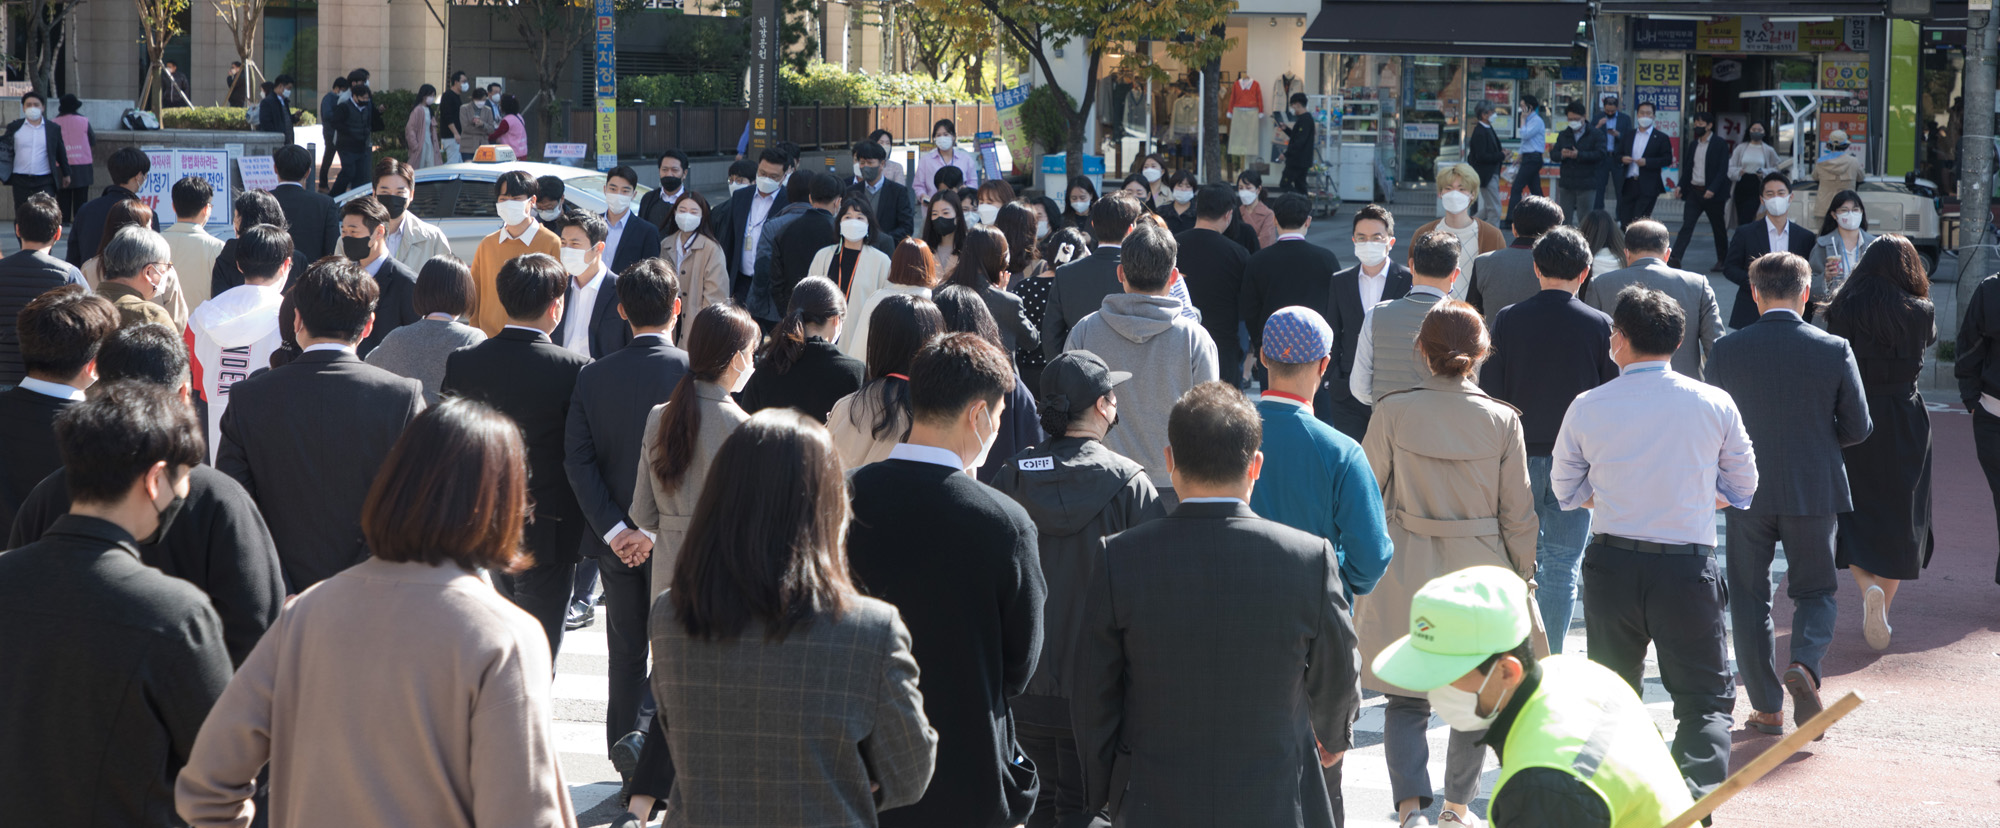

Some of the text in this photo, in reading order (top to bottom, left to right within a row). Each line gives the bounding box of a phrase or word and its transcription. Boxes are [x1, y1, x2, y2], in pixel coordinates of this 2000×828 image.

[599, 17, 610, 31] P
[758, 16, 767, 59] 한강공원
[1744, 29, 1796, 44] 황소갈비
[599, 34, 613, 82] 주차장
[1598, 74, 1610, 84] 42
[1639, 64, 1679, 81] 전당포
[995, 86, 1028, 108] 명품수선
[602, 114, 611, 152] 스튜디오
[181, 155, 218, 169] 합법화하려는
[1023, 459, 1050, 469] OFF
